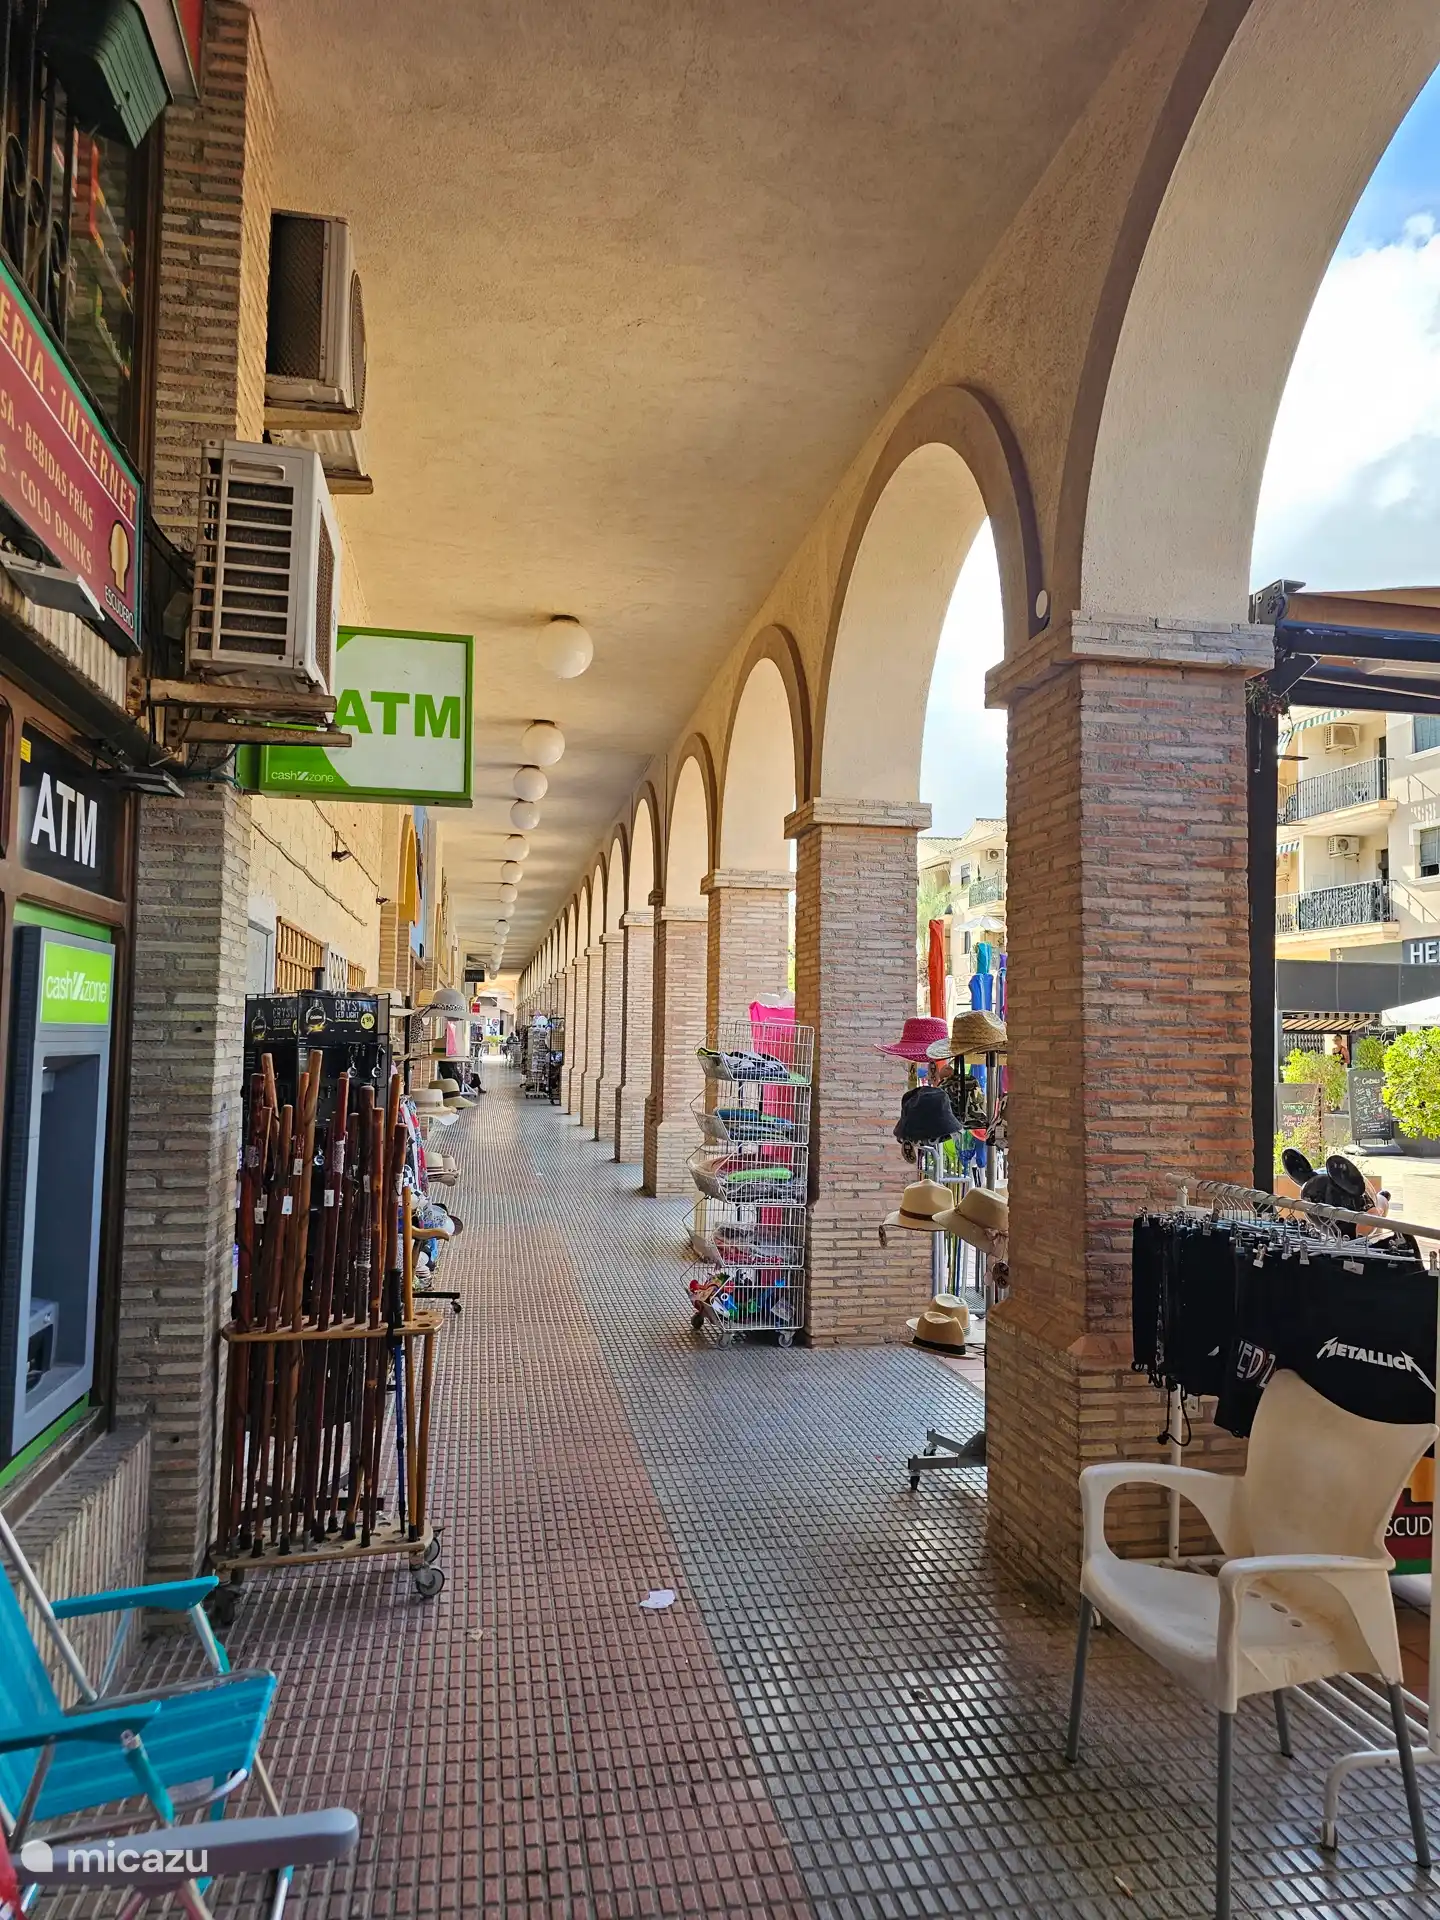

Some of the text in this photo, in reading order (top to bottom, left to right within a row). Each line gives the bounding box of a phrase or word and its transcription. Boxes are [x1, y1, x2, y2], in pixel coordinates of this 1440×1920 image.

[25, 421, 68, 498] BEBIDAS
[68, 481, 94, 532] FRÍAS
[60, 389, 136, 521] INTERNET
[20, 470, 51, 526] COLD
[55, 510, 93, 575] DRINKS
[104, 584, 135, 630] ESCUDERO
[335, 688, 461, 740] ATM
[30, 771, 98, 869] ATM
[1409, 940, 1440, 964] HE
[1316, 1336, 1436, 1393] METALLICA
